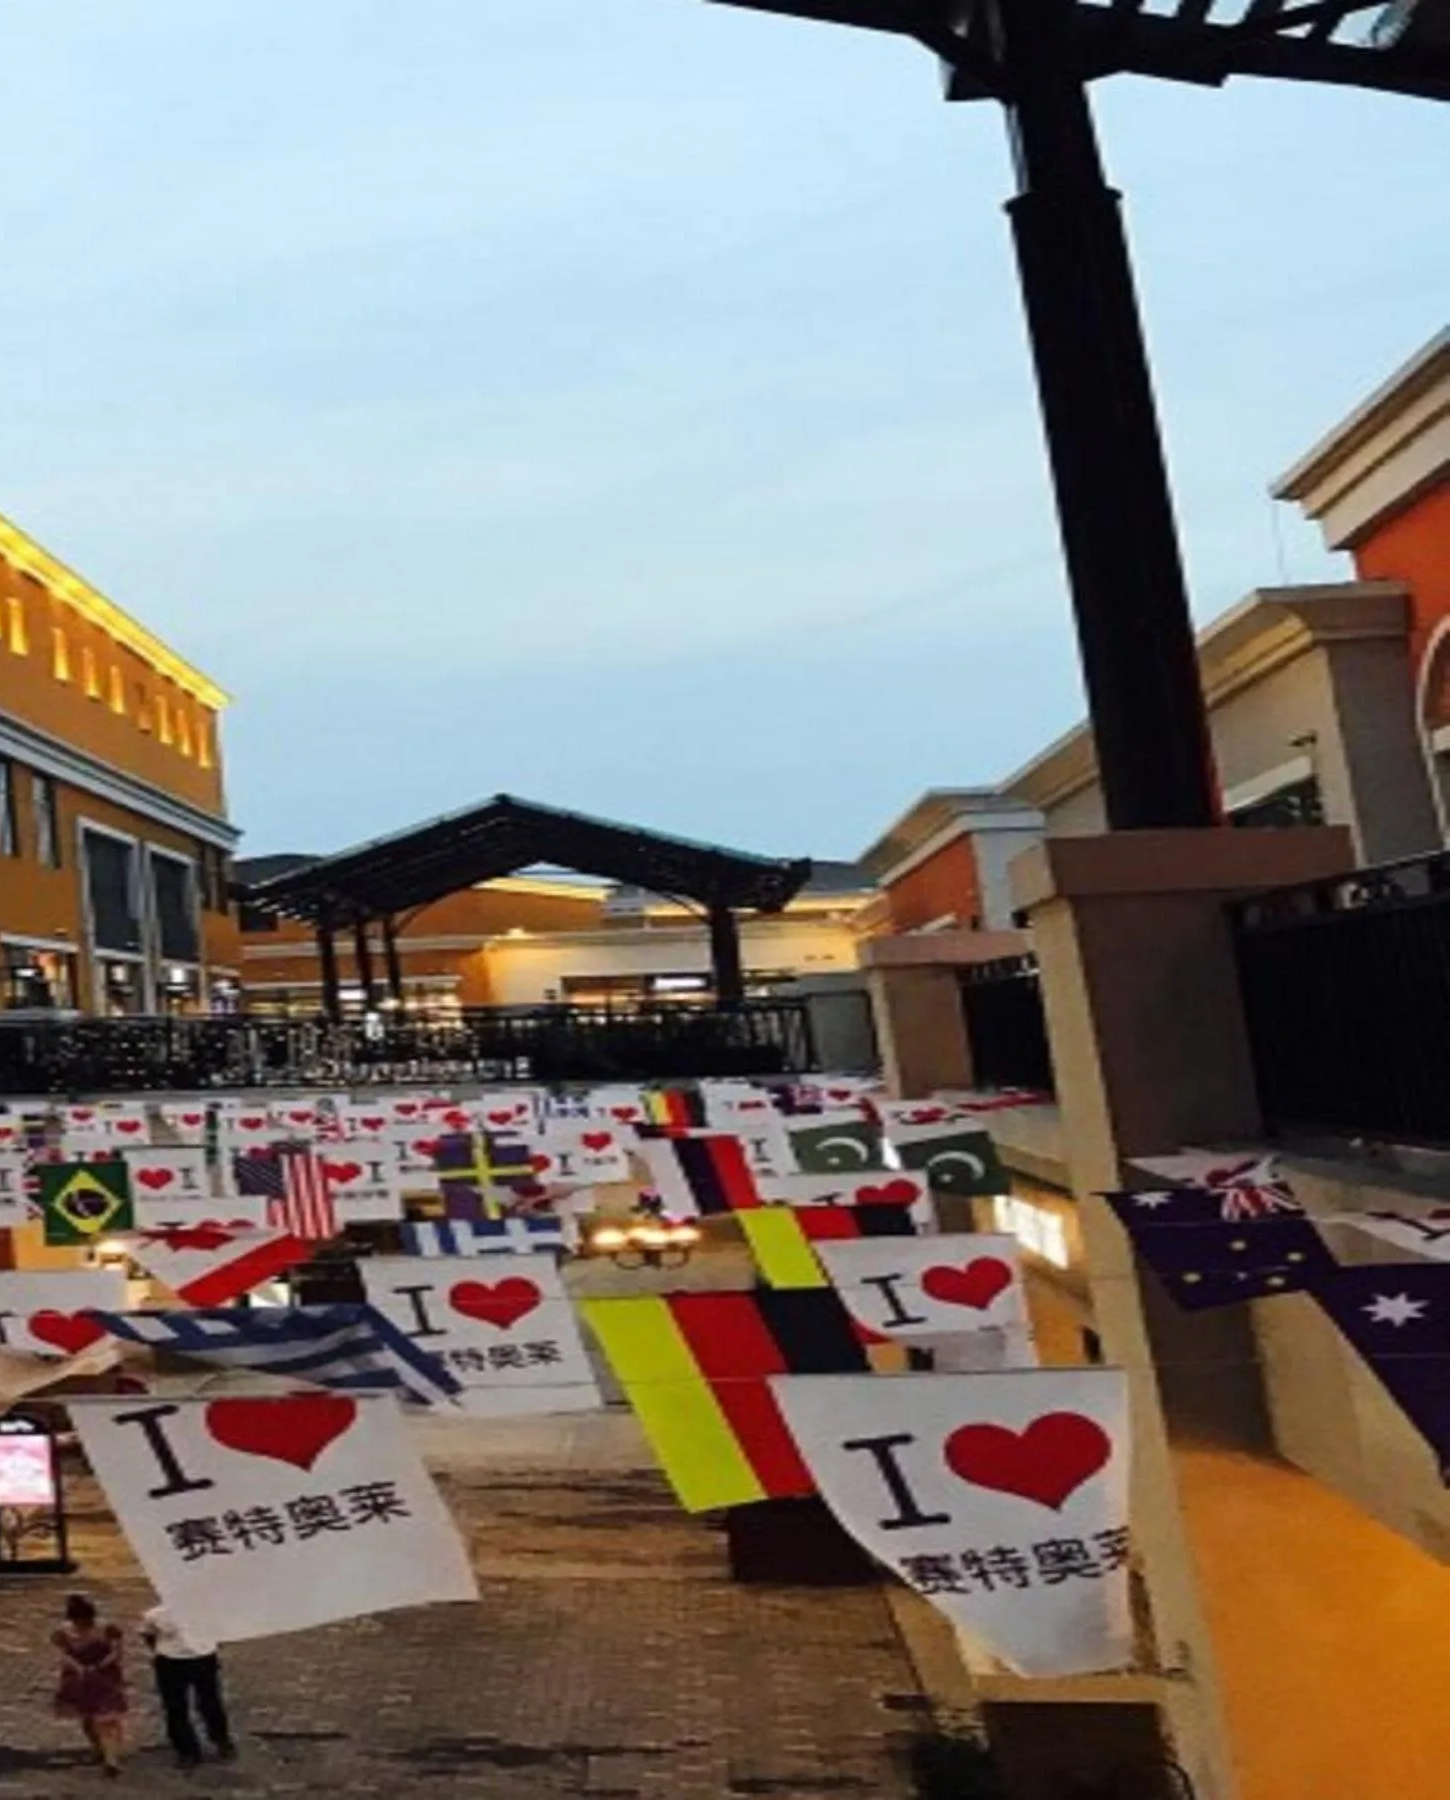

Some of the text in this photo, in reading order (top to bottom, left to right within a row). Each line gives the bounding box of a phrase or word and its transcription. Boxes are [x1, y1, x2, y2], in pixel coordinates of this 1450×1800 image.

[393, 1285, 447, 1337] I
[860, 1273, 927, 1328] I
[112, 1404, 214, 1499] I
[842, 1432, 952, 1530] I
[165, 1481, 411, 1562] 赛特奥莱
